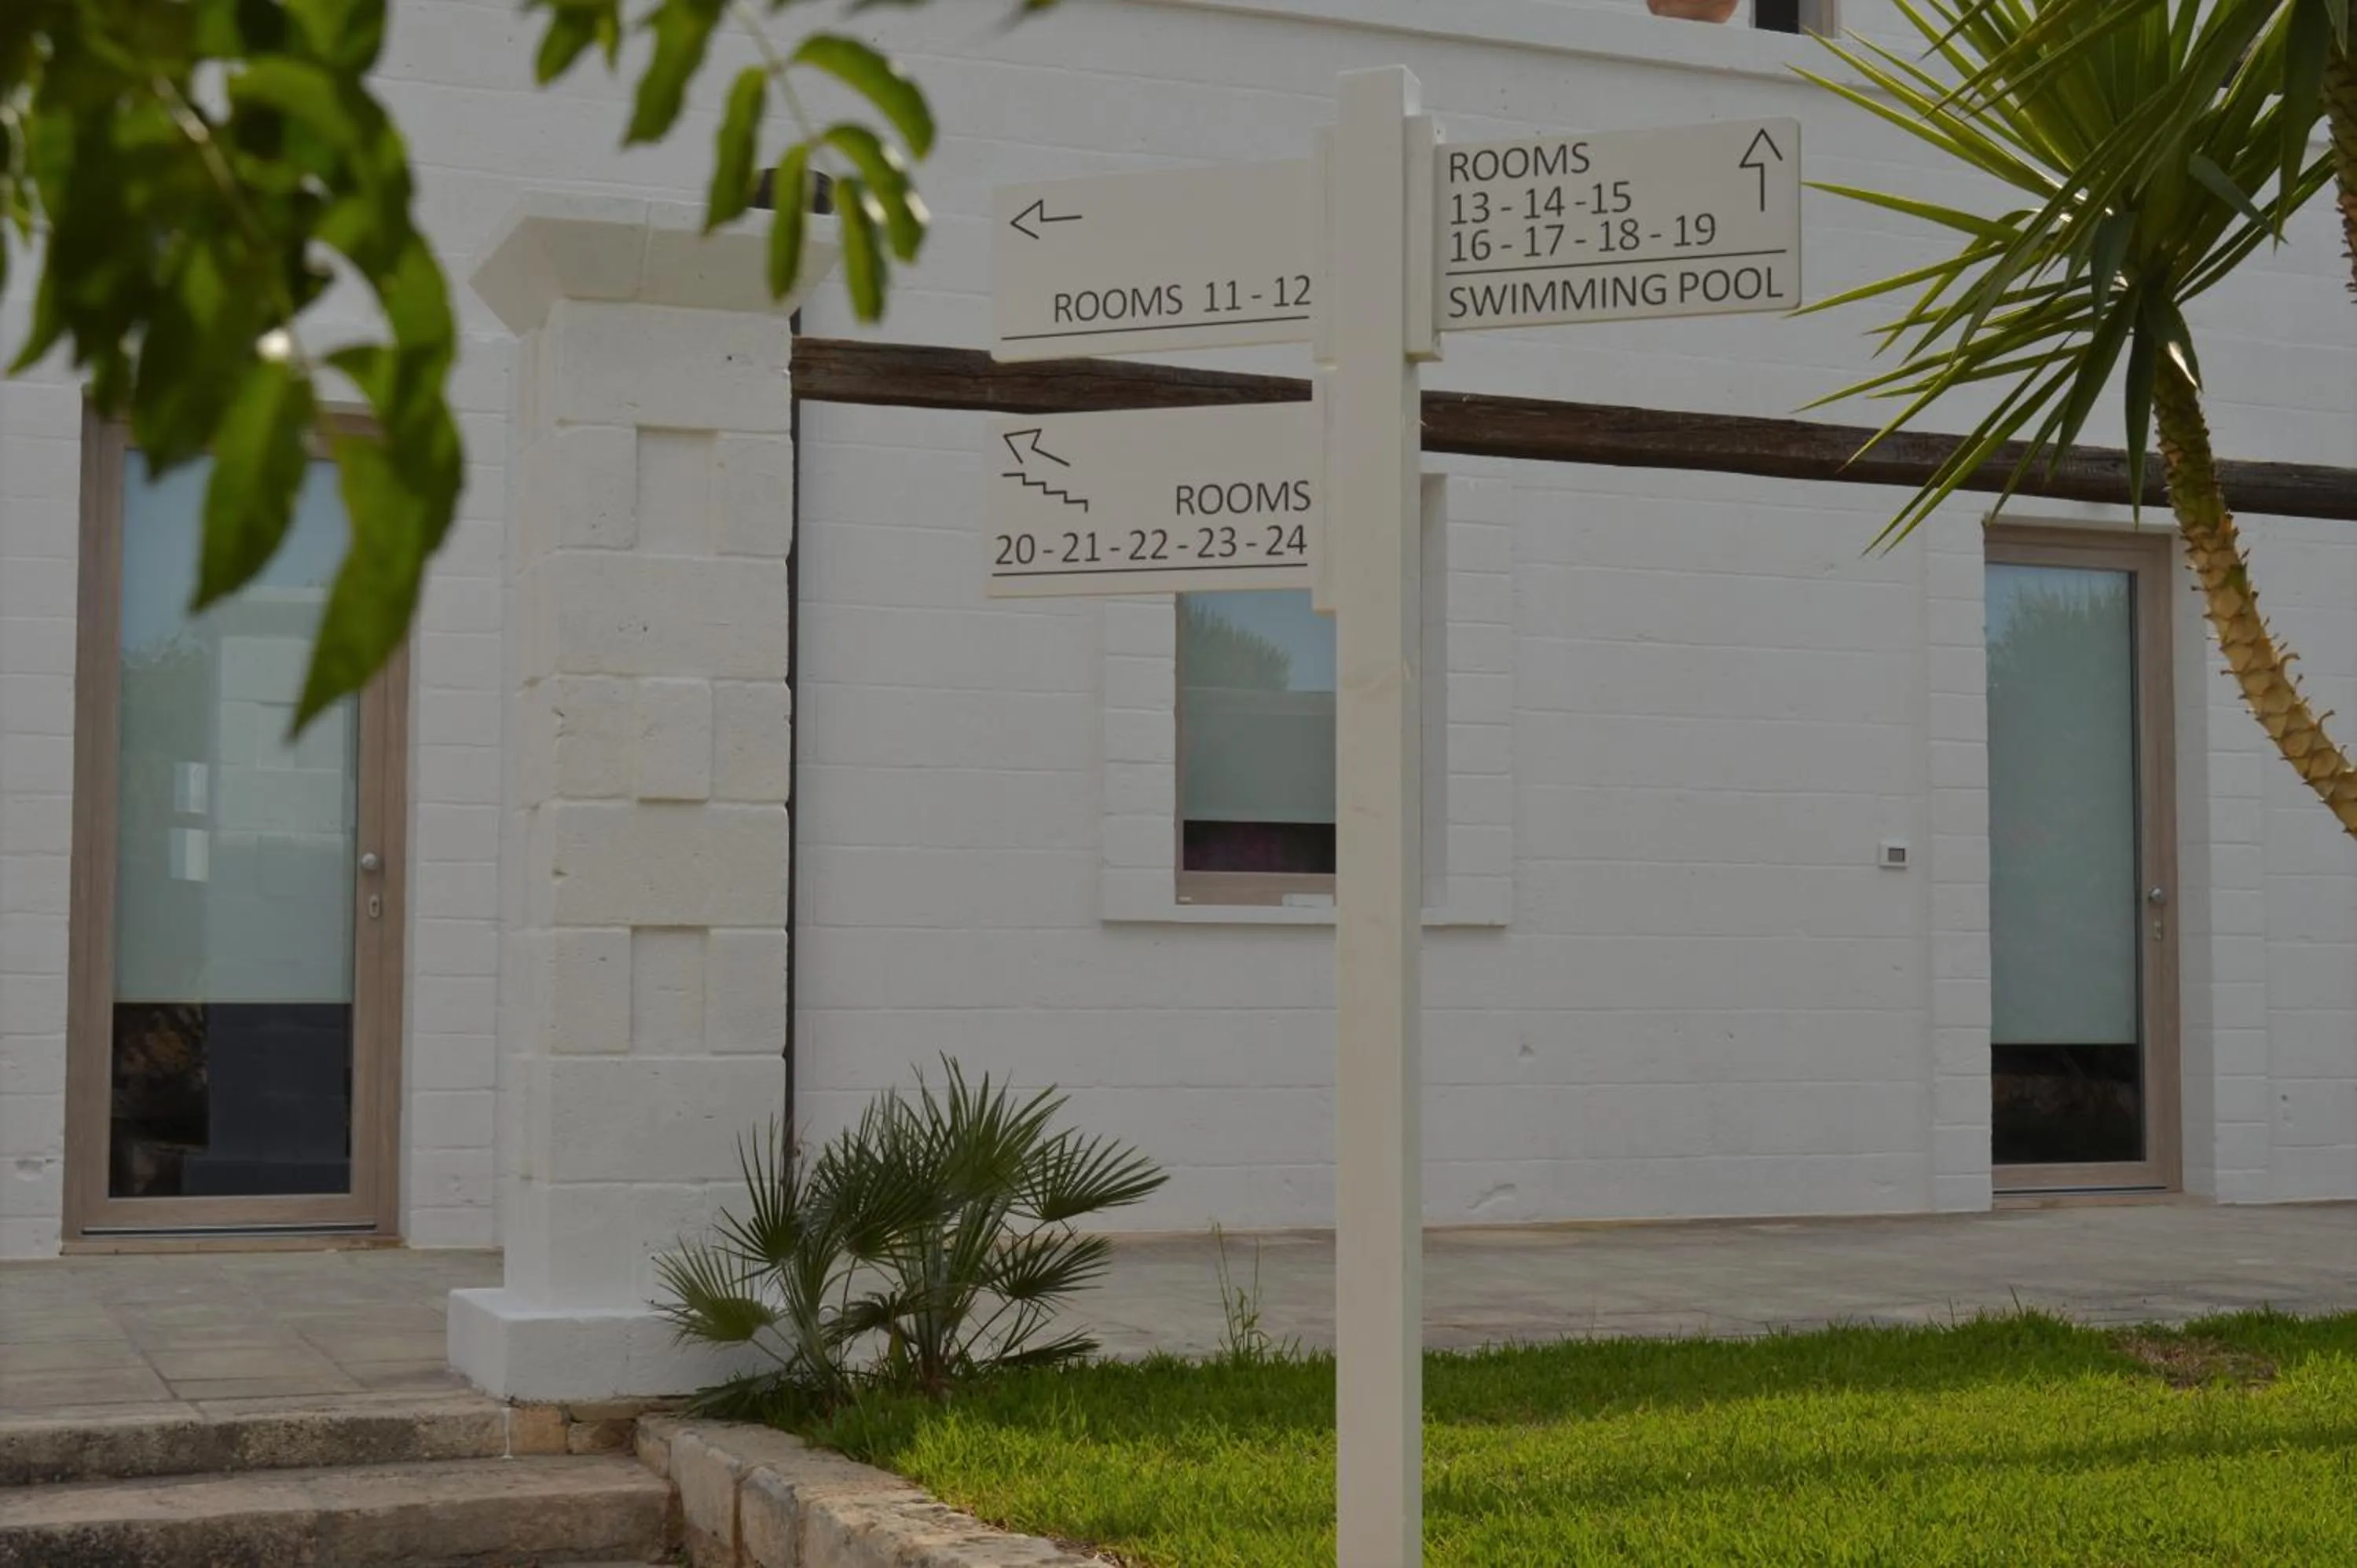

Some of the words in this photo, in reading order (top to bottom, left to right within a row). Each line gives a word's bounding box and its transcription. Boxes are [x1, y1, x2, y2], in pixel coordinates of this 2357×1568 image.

[1450, 141, 1590, 183] ROOMS
[1054, 284, 1183, 324] ROOMS
[1448, 273, 1667, 318] SWIMMING
[1679, 266, 1784, 304] POOL
[1176, 479, 1311, 516] ROOMS
